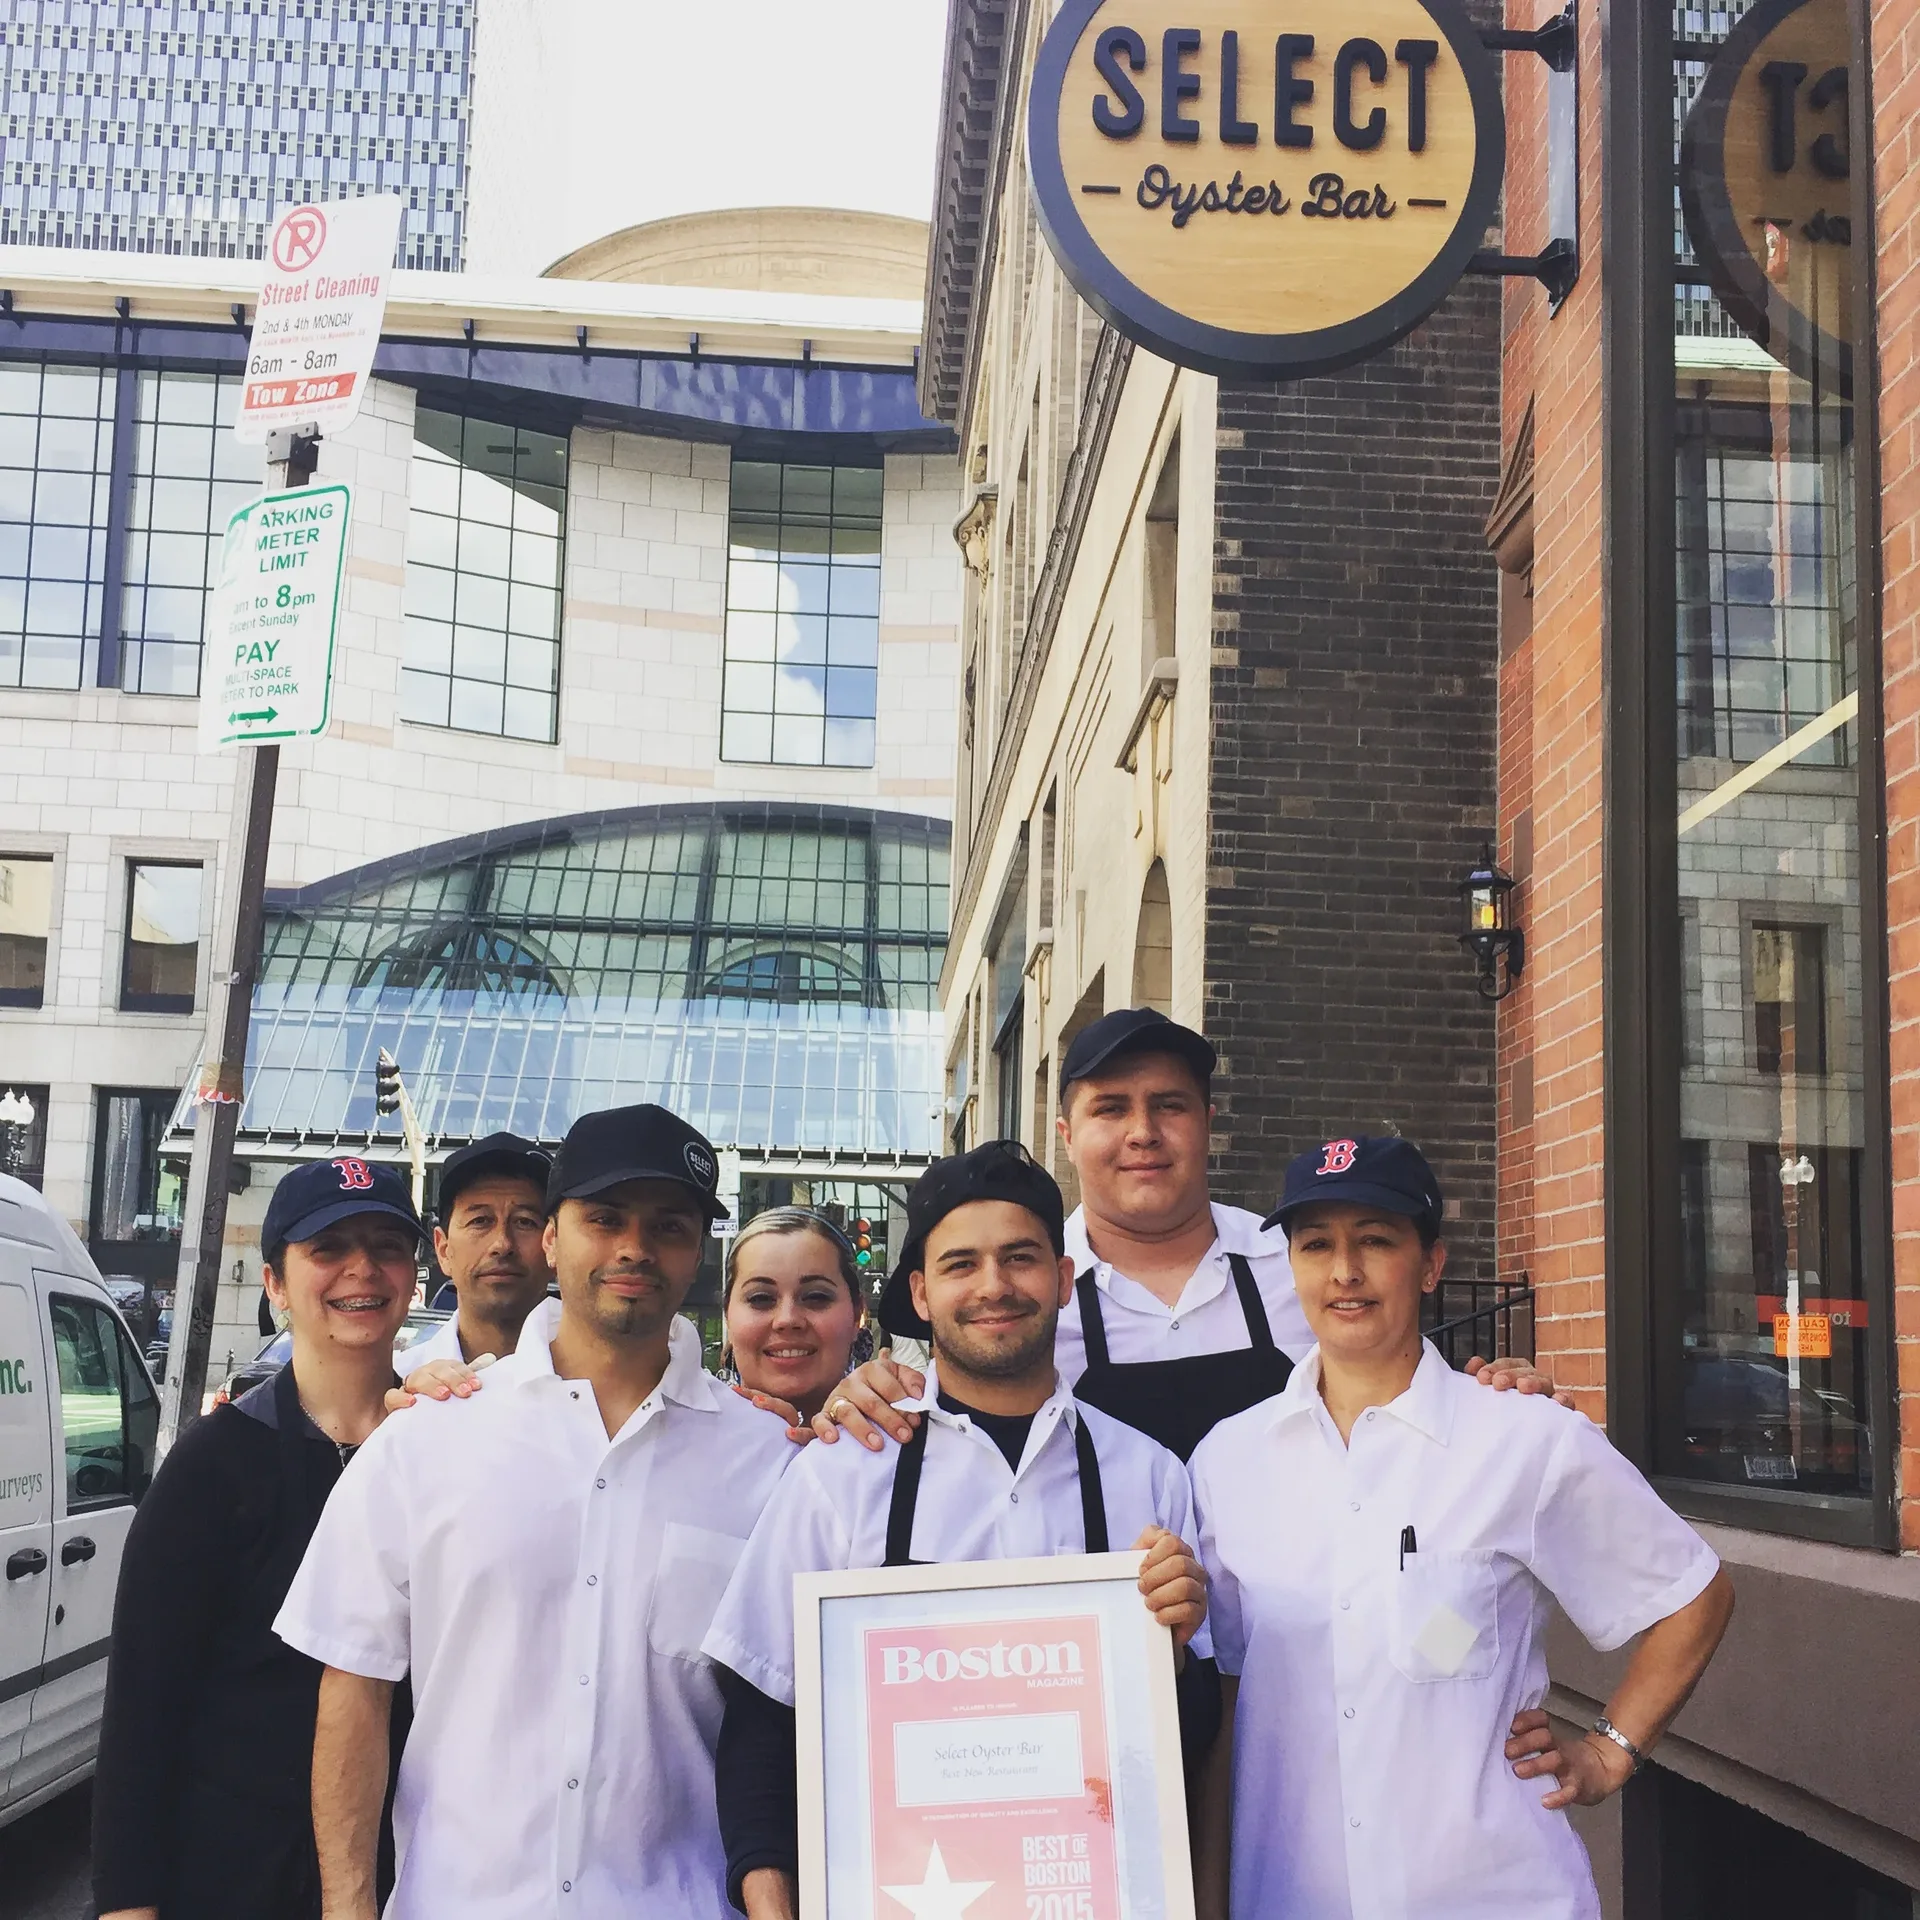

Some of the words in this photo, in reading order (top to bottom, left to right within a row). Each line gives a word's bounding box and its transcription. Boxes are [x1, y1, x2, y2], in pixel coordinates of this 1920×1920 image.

[1092, 26, 1440, 152] SELECT
[1136, 163, 1292, 229] Oyster
[1300, 172, 1397, 219] Bar
[262, 279, 310, 306] Street
[315, 272, 380, 300] Cleaning
[262, 319, 280, 335] 2nd
[282, 317, 290, 333] &
[294, 317, 309, 331] 4th
[312, 312, 354, 329] MONDAY
[250, 355, 283, 375] 6am
[303, 349, 338, 370] 8am
[251, 384, 288, 406] Tow
[293, 380, 339, 403] Zone
[259, 502, 334, 529] ARKING
[255, 527, 320, 553] METER
[259, 551, 309, 574] LIMIT
[255, 596, 269, 609] to
[275, 583, 316, 610] 8pm
[258, 612, 300, 628] Sunday
[234, 638, 281, 668] PAY
[221, 687, 245, 705] ETER
[248, 685, 264, 698] TO
[266, 682, 300, 697] PARK
[1315, 1137, 1359, 1176] B
[331, 1156, 375, 1190] B
[0, 1358, 33, 1395] nc.
[0, 1472, 43, 1502] urveys
[880, 1639, 1084, 1685] Boston
[1026, 1676, 1085, 1689] MAGAZINE
[934, 1743, 968, 1761] Select
[972, 1744, 1014, 1763] Oyster
[1018, 1741, 1044, 1756] Bar
[1022, 1834, 1069, 1861] BEST
[1072, 1837, 1088, 1854] OF
[1024, 1860, 1091, 1886] BOSTON
[1026, 1891, 1095, 1920] 2015
